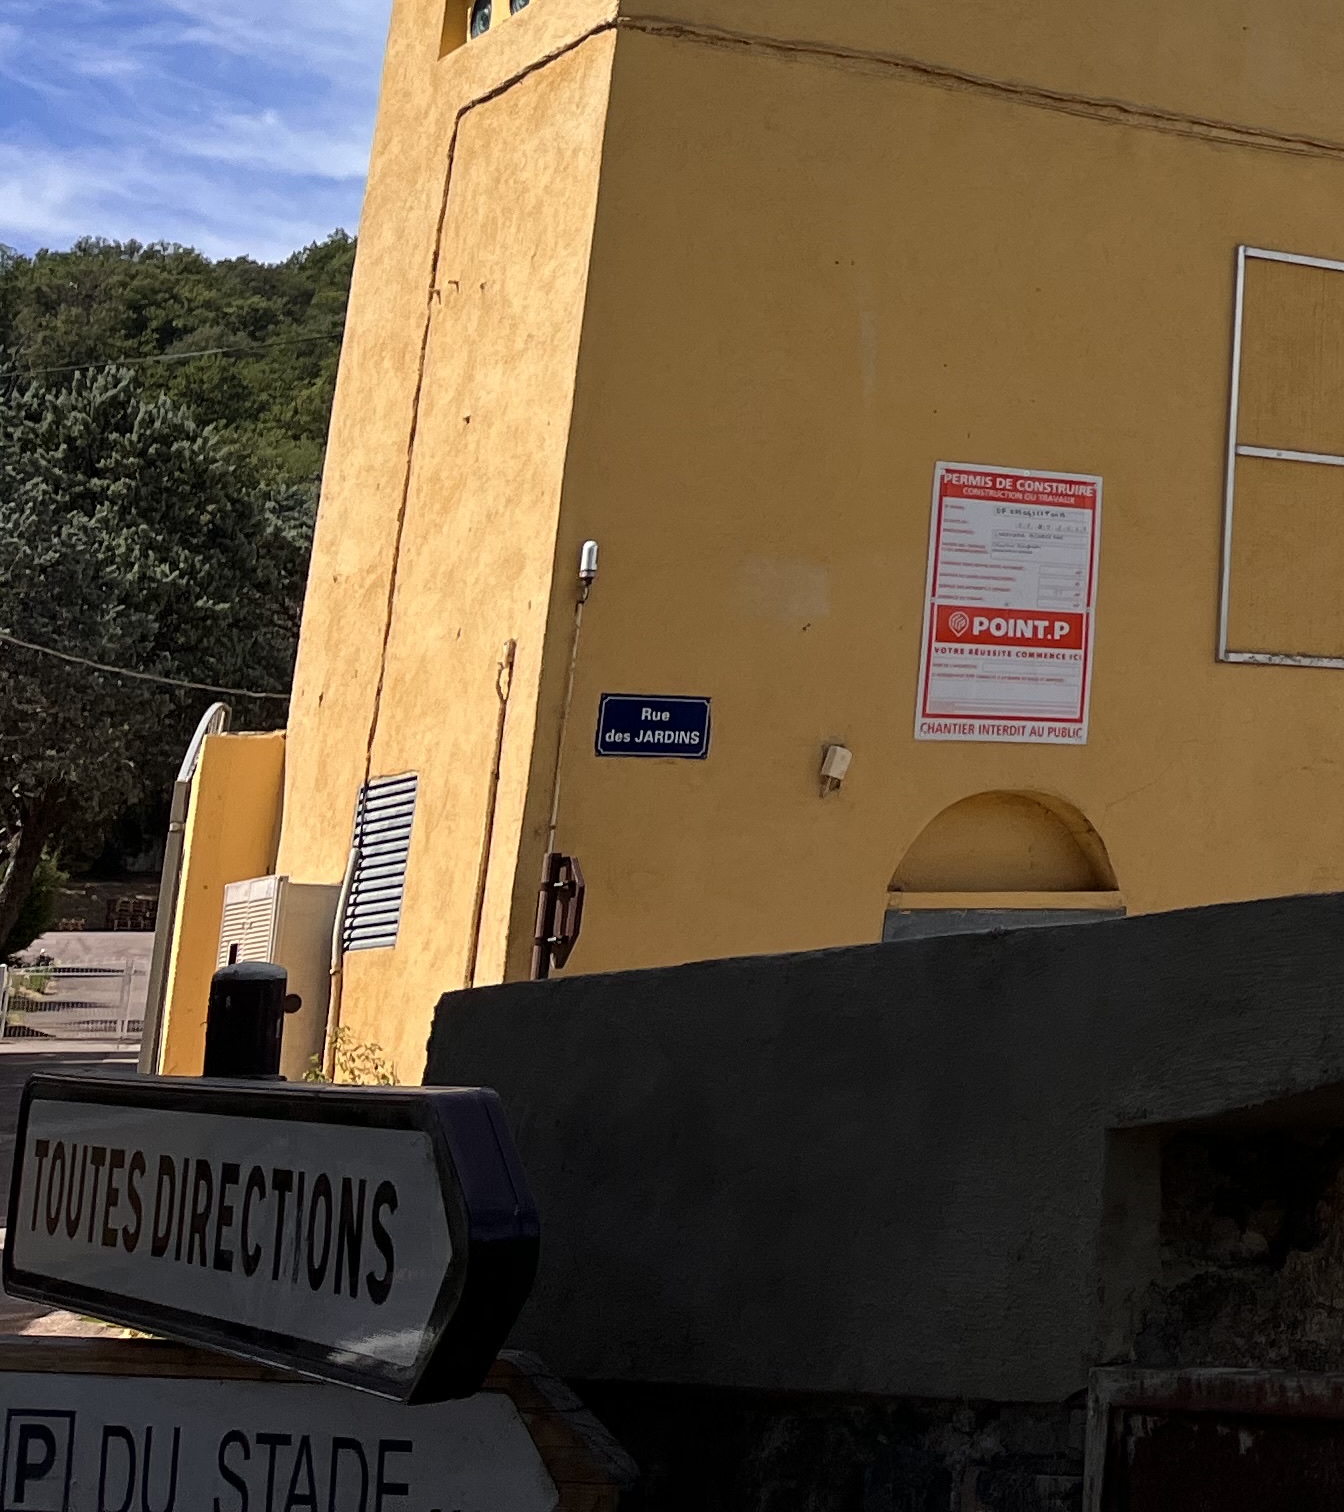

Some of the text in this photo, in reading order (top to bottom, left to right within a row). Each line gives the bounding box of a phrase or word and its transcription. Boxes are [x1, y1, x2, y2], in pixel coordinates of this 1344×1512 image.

[943, 474, 1094, 496] PERMIS DE CONSTRUIRE
[962, 487, 1022, 500] CONSTRUCTION
[1039, 494, 1075, 504] TRAVAUX
[973, 617, 1070, 640] POINT.P
[934, 647, 965, 655] VOTRE
[968, 648, 1012, 658] RÉUSSITE
[1015, 651, 1066, 660] COMMENCE
[641, 707, 670, 721] Rue
[605, 729, 700, 744] des JARDINS
[920, 722, 1082, 738] CHANTIER INTERDIT AU PUBLIC
[31, 1139, 399, 1305] TOUTES DIRECTIONS
[98, 1425, 182, 1512] DU
[213, 1429, 413, 1512] STADE
